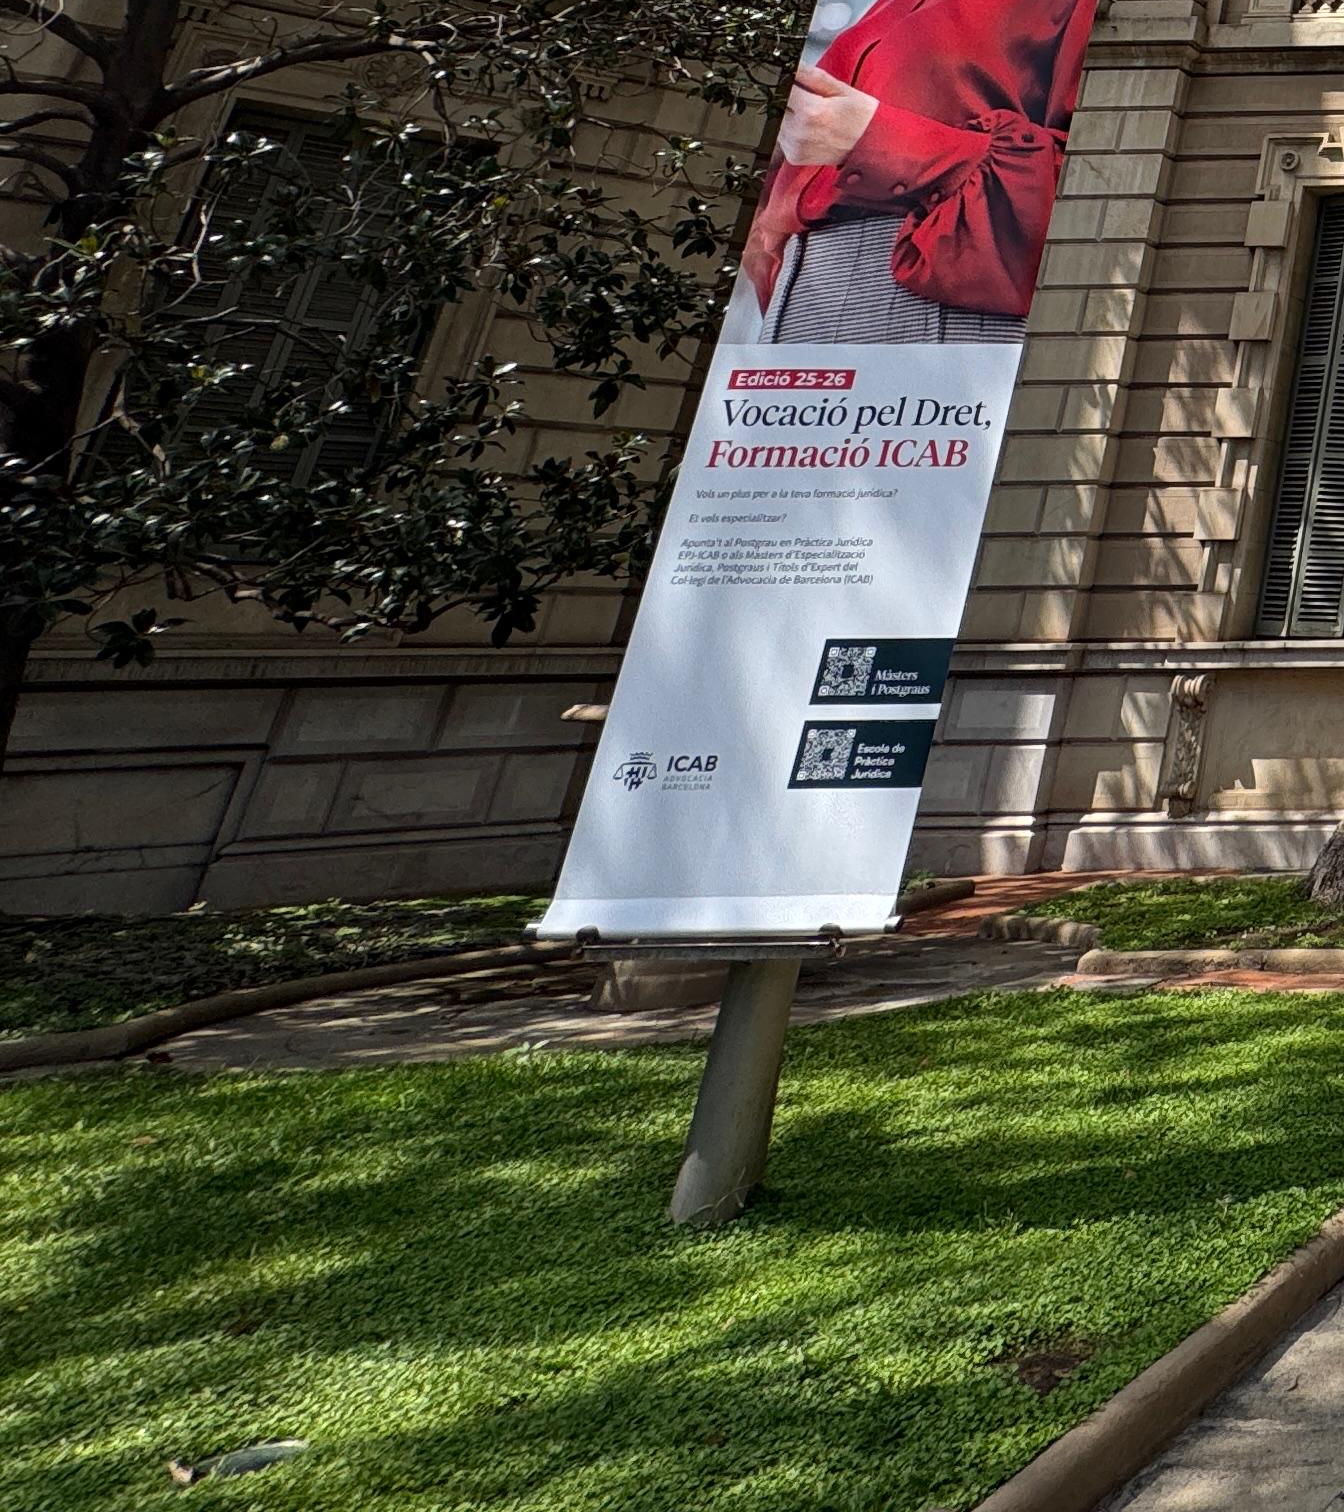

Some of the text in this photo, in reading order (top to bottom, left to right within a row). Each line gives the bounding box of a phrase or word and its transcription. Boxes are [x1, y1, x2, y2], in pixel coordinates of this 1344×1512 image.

[735, 370, 847, 387] Edició 25-26
[722, 396, 992, 434] Vocació pel Dret,
[704, 438, 970, 469] Formació ICAB
[696, 489, 715, 499] Vols
[717, 491, 730, 499] un
[730, 490, 751, 500] plus
[752, 491, 769, 500] per
[780, 489, 789, 498] la
[791, 490, 811, 498] teva
[814, 489, 856, 498] formació
[856, 489, 898, 500] jurídica?
[701, 513, 719, 523] vols
[721, 513, 787, 524] especialitzar?
[680, 537, 874, 550] Apunta't al Postgrau en Pràctica Jurídica
[678, 551, 720, 560] EPJ-ICAB
[729, 550, 744, 560] als
[785, 548, 866, 561] d'Especialització
[673, 562, 715, 573] Jurídica,
[717, 563, 765, 574] Postgraus
[801, 562, 841, 574] d'Expert
[843, 562, 859, 572] del
[707, 575, 721, 585] de
[721, 574, 778, 585] l'Advocacia
[779, 575, 792, 585] de
[794, 574, 841, 585] Barcelona
[844, 574, 874, 585] (ICAB)
[876, 684, 931, 697] Postgraus
[857, 742, 906, 754] Escola de
[666, 754, 719, 773] ICAB
[853, 756, 896, 767] Pràctica
[662, 775, 713, 783] ADVOCACIA
[850, 768, 892, 780] Jurídica
[661, 783, 711, 791] BARCELONA
